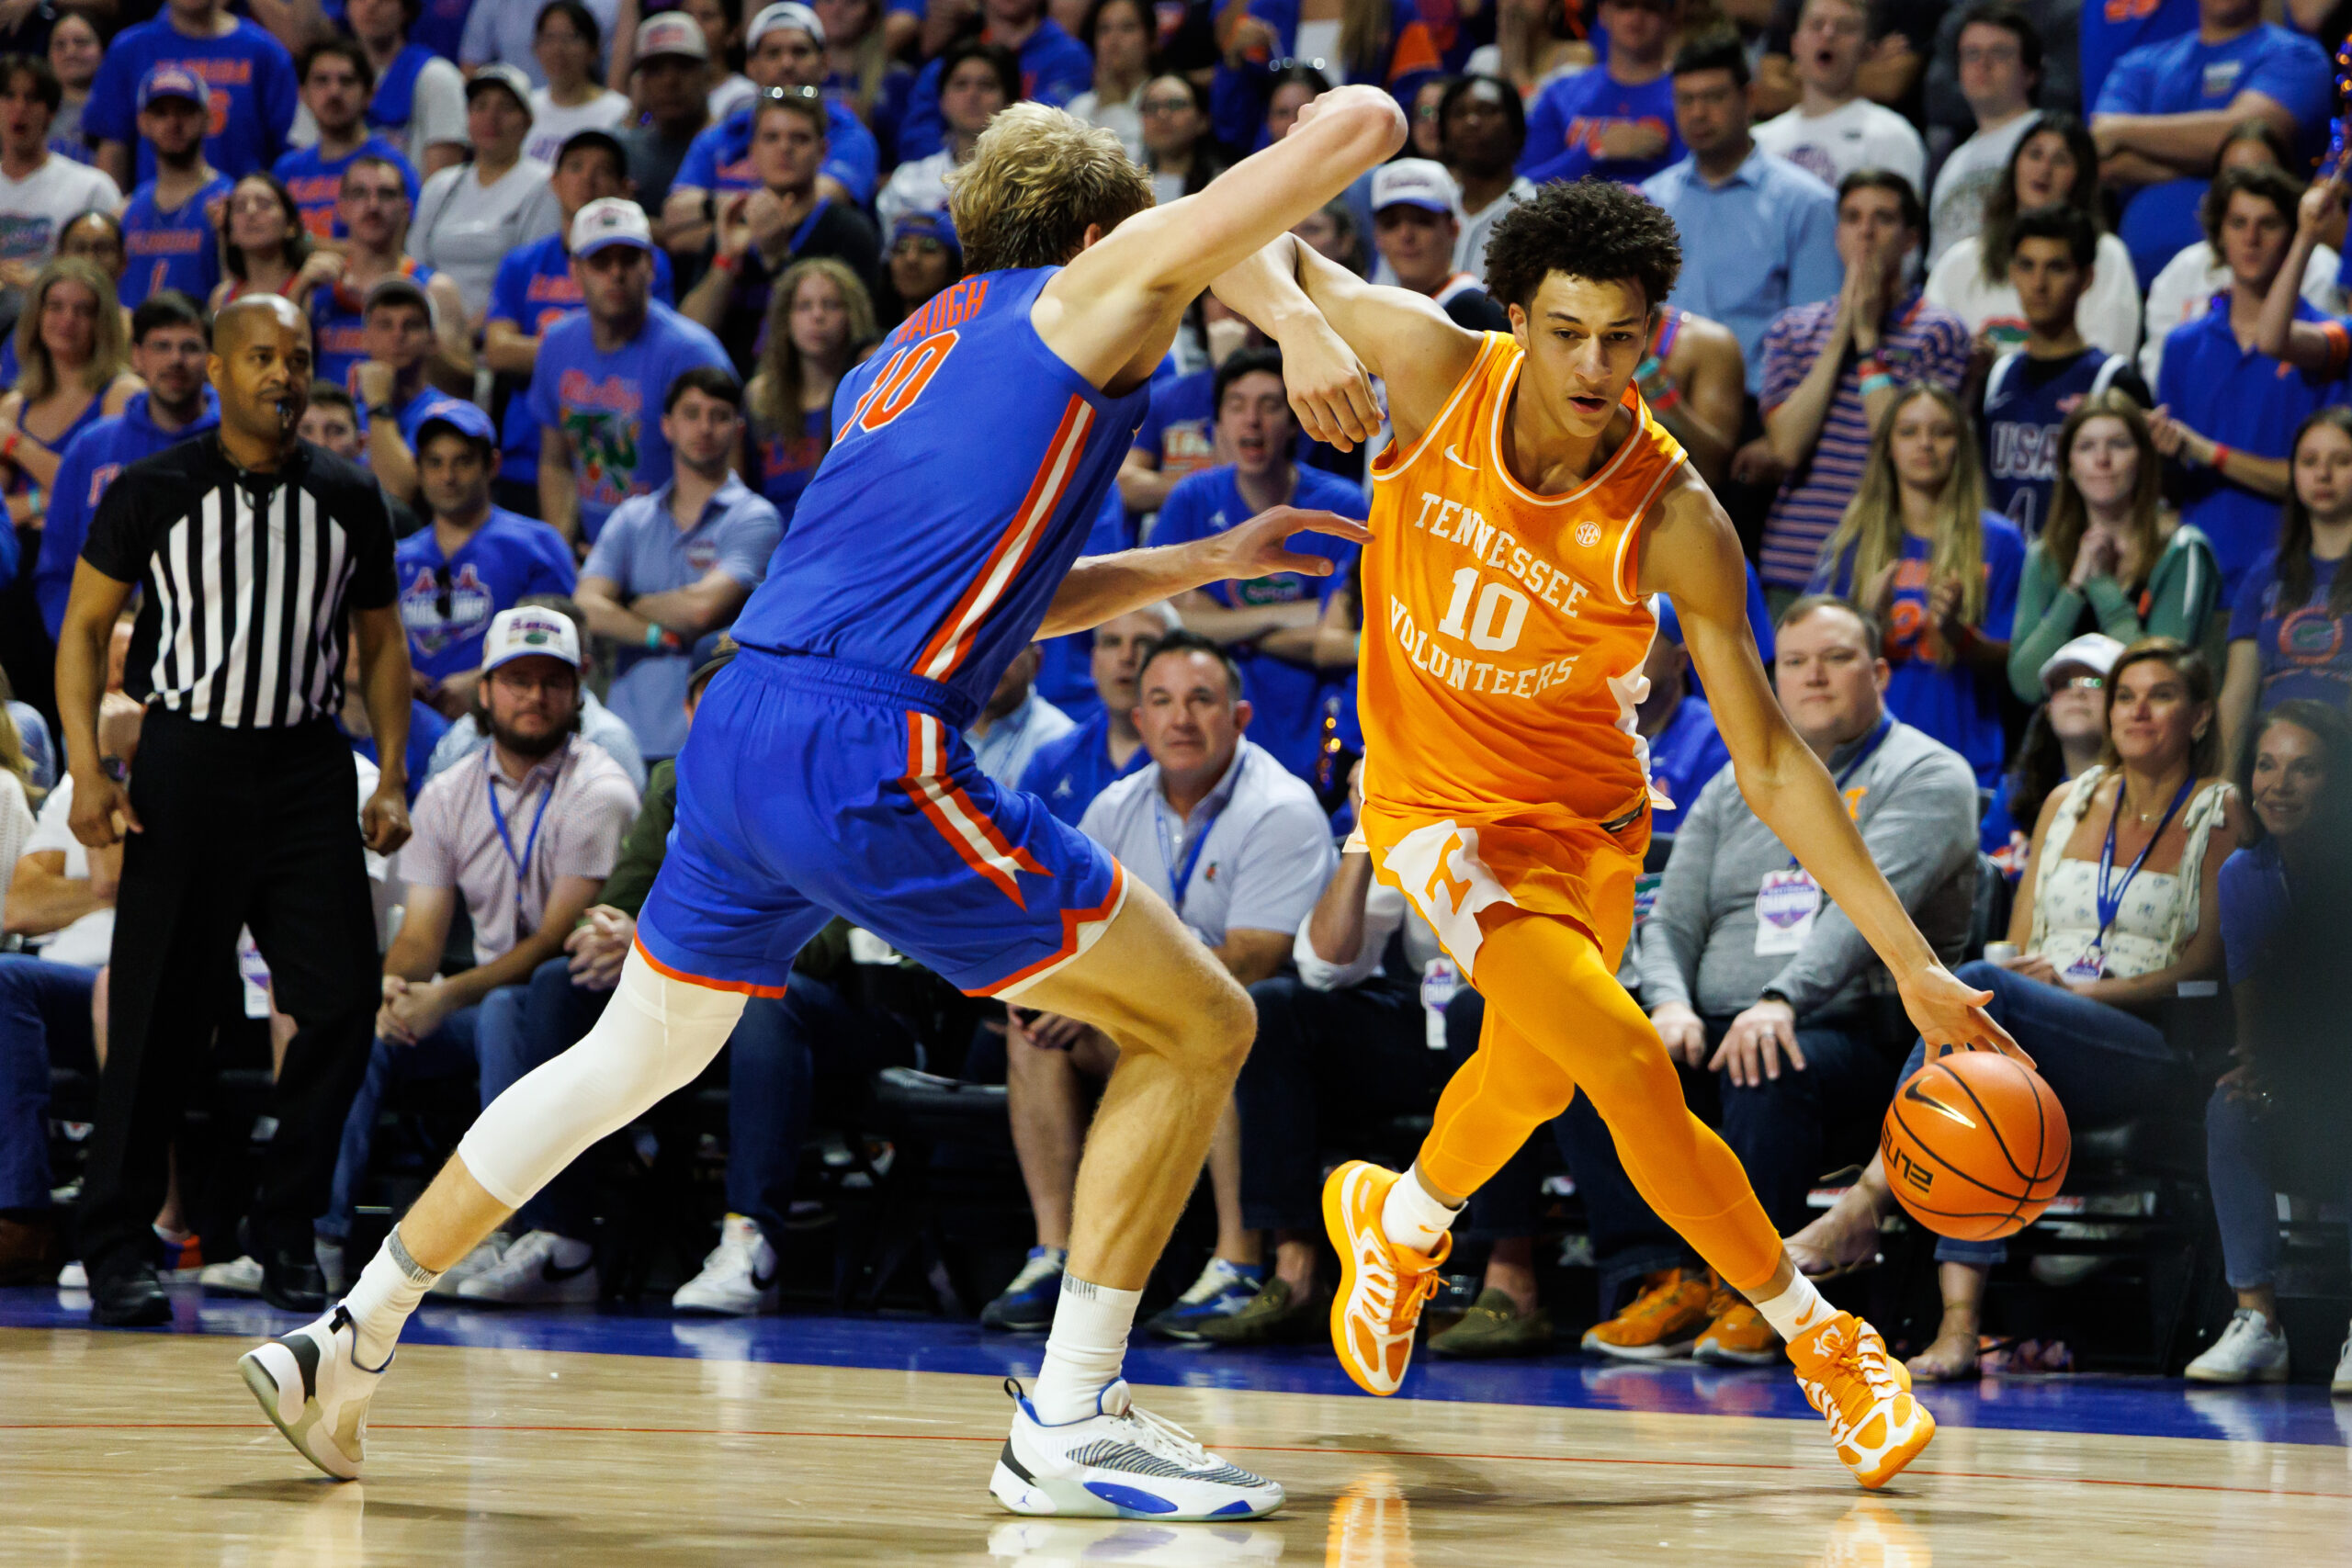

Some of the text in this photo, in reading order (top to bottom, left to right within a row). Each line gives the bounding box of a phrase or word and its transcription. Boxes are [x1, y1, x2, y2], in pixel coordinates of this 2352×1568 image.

[893, 280, 989, 347] HAUGH
[830, 329, 961, 451] 10
[1990, 421, 2064, 481] USA
[1415, 491, 1589, 618] TENNESSEE
[1577, 523, 1600, 546] SEC
[1391, 593, 1581, 699] VOLUNTEERS
[1438, 567, 1531, 652] 10
[1881, 1120, 1934, 1194] ELITE
